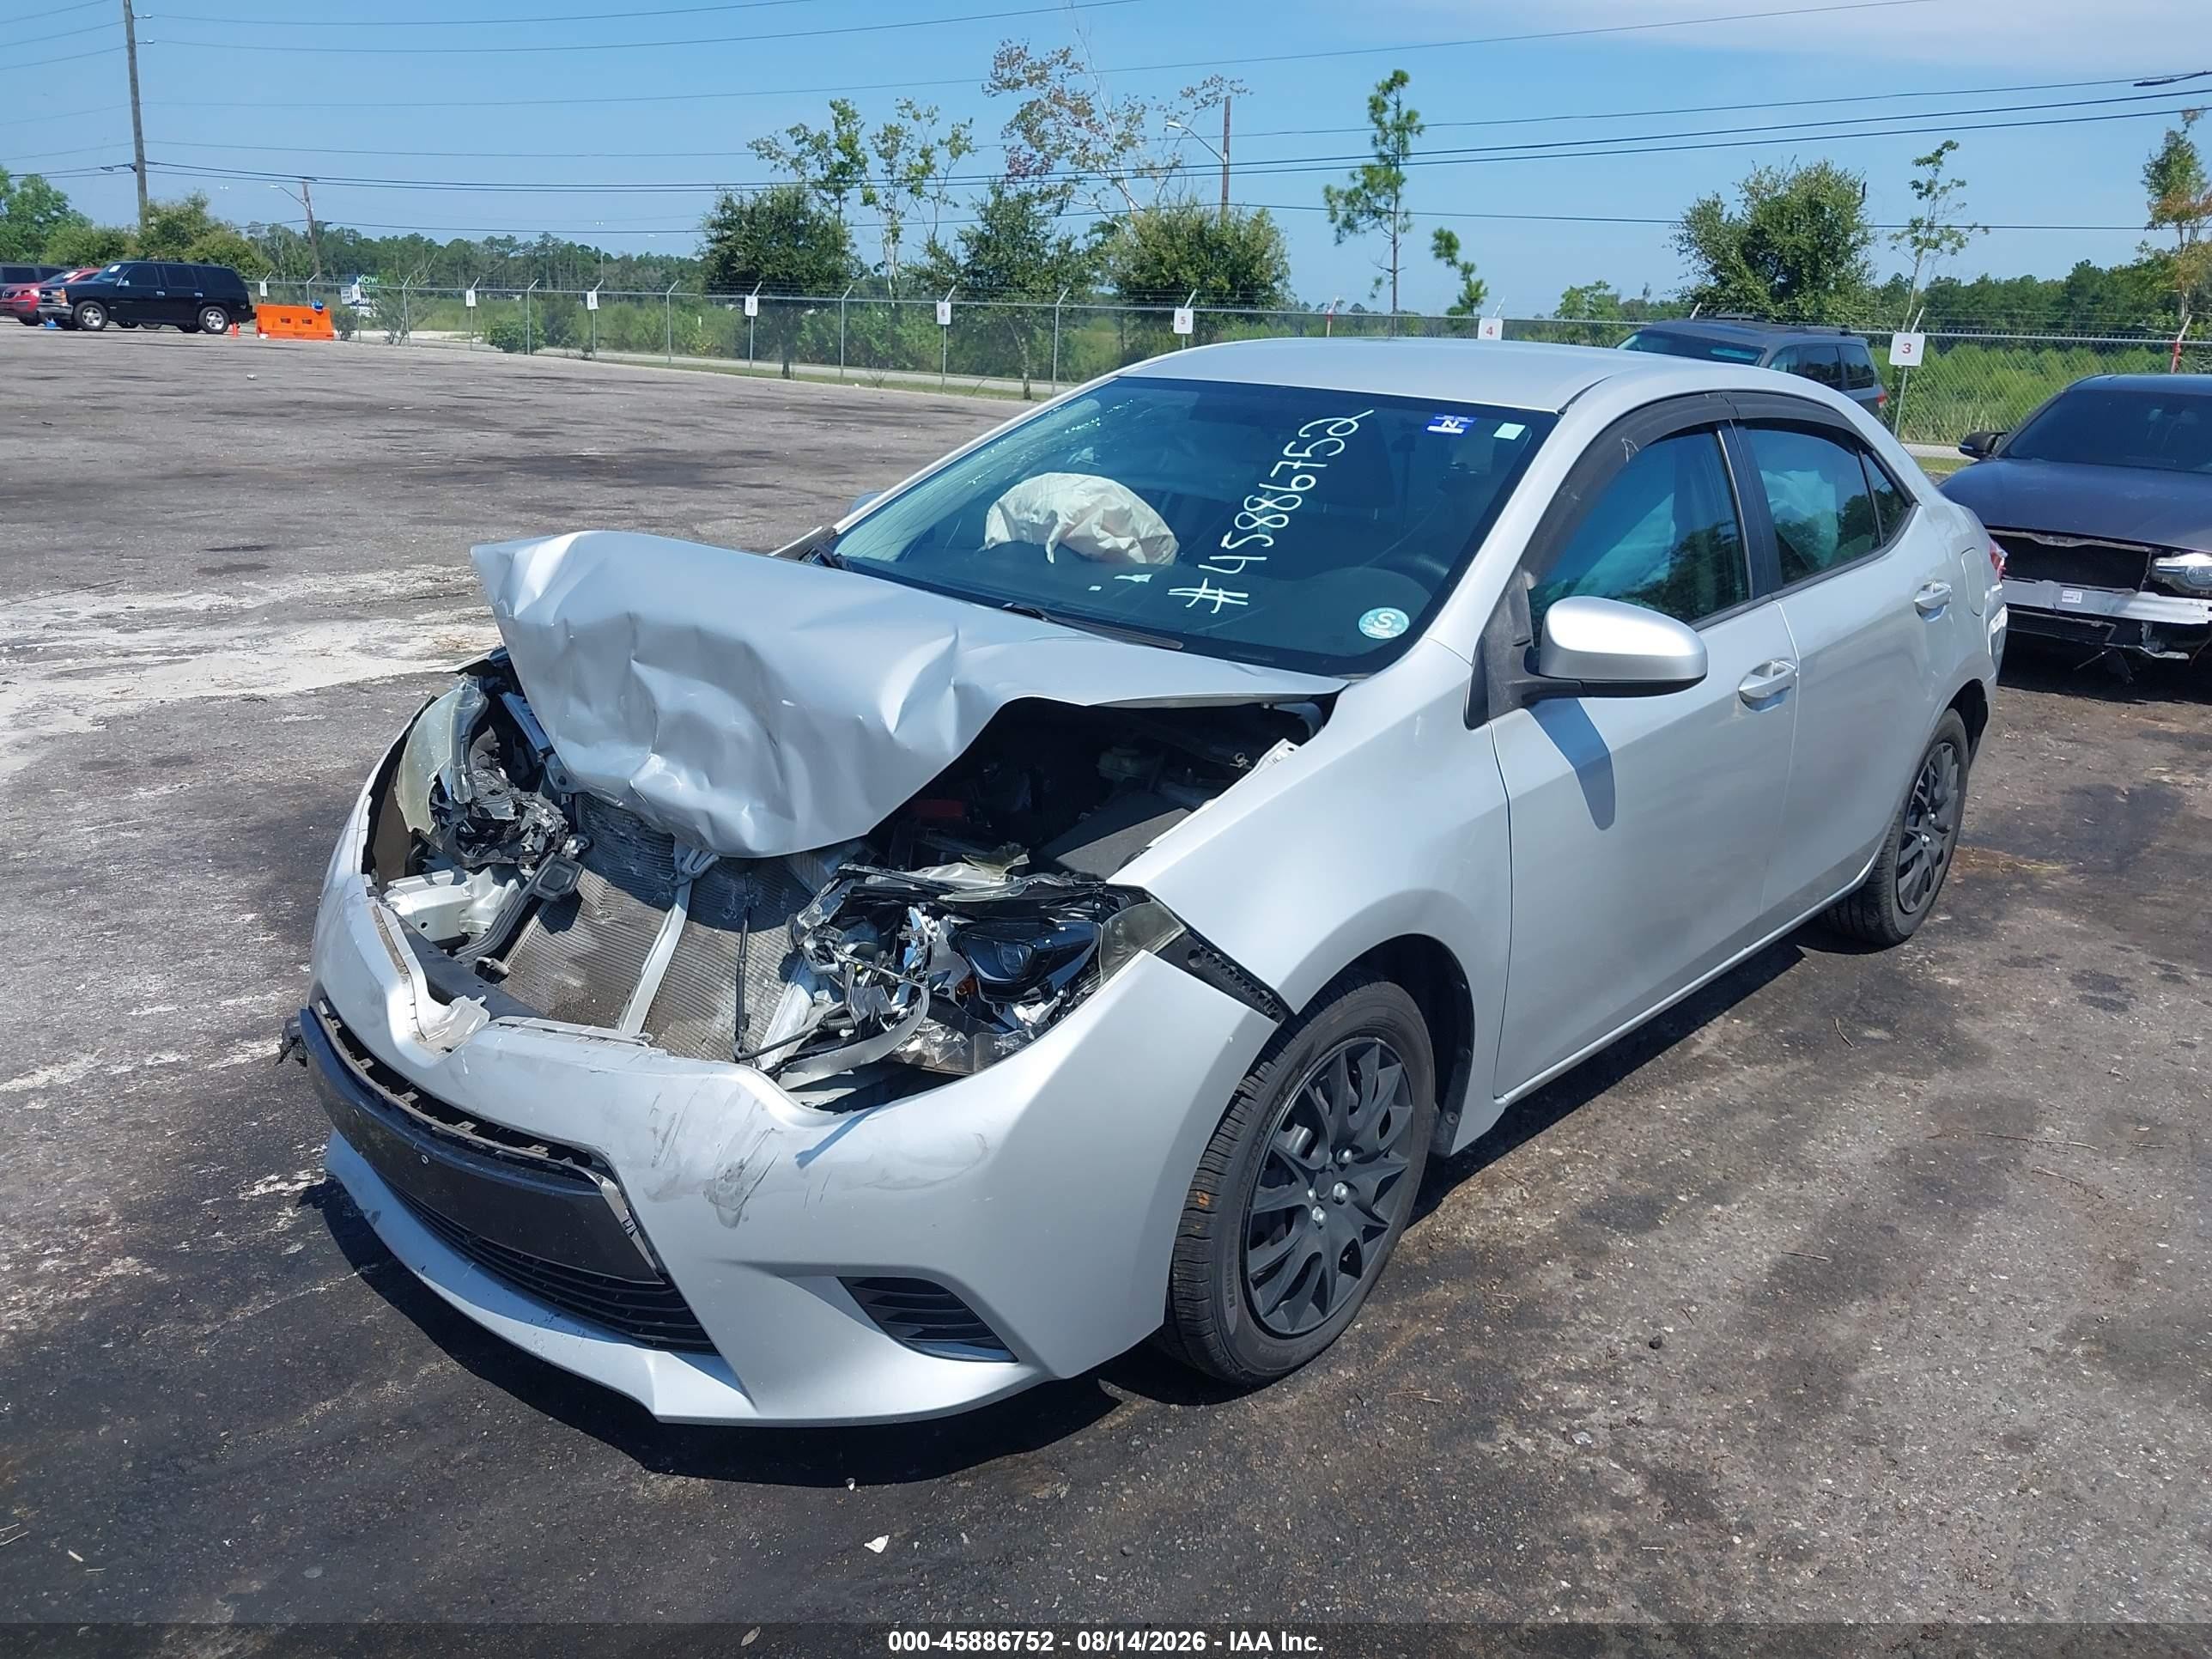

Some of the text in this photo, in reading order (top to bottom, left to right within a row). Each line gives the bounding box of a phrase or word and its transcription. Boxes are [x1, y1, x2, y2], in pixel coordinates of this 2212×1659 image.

[1181, 316, 1187, 325] 5
[1486, 325, 1493, 336] 4
[1902, 343, 1911, 354] 3
[1373, 612, 1396, 629] S
